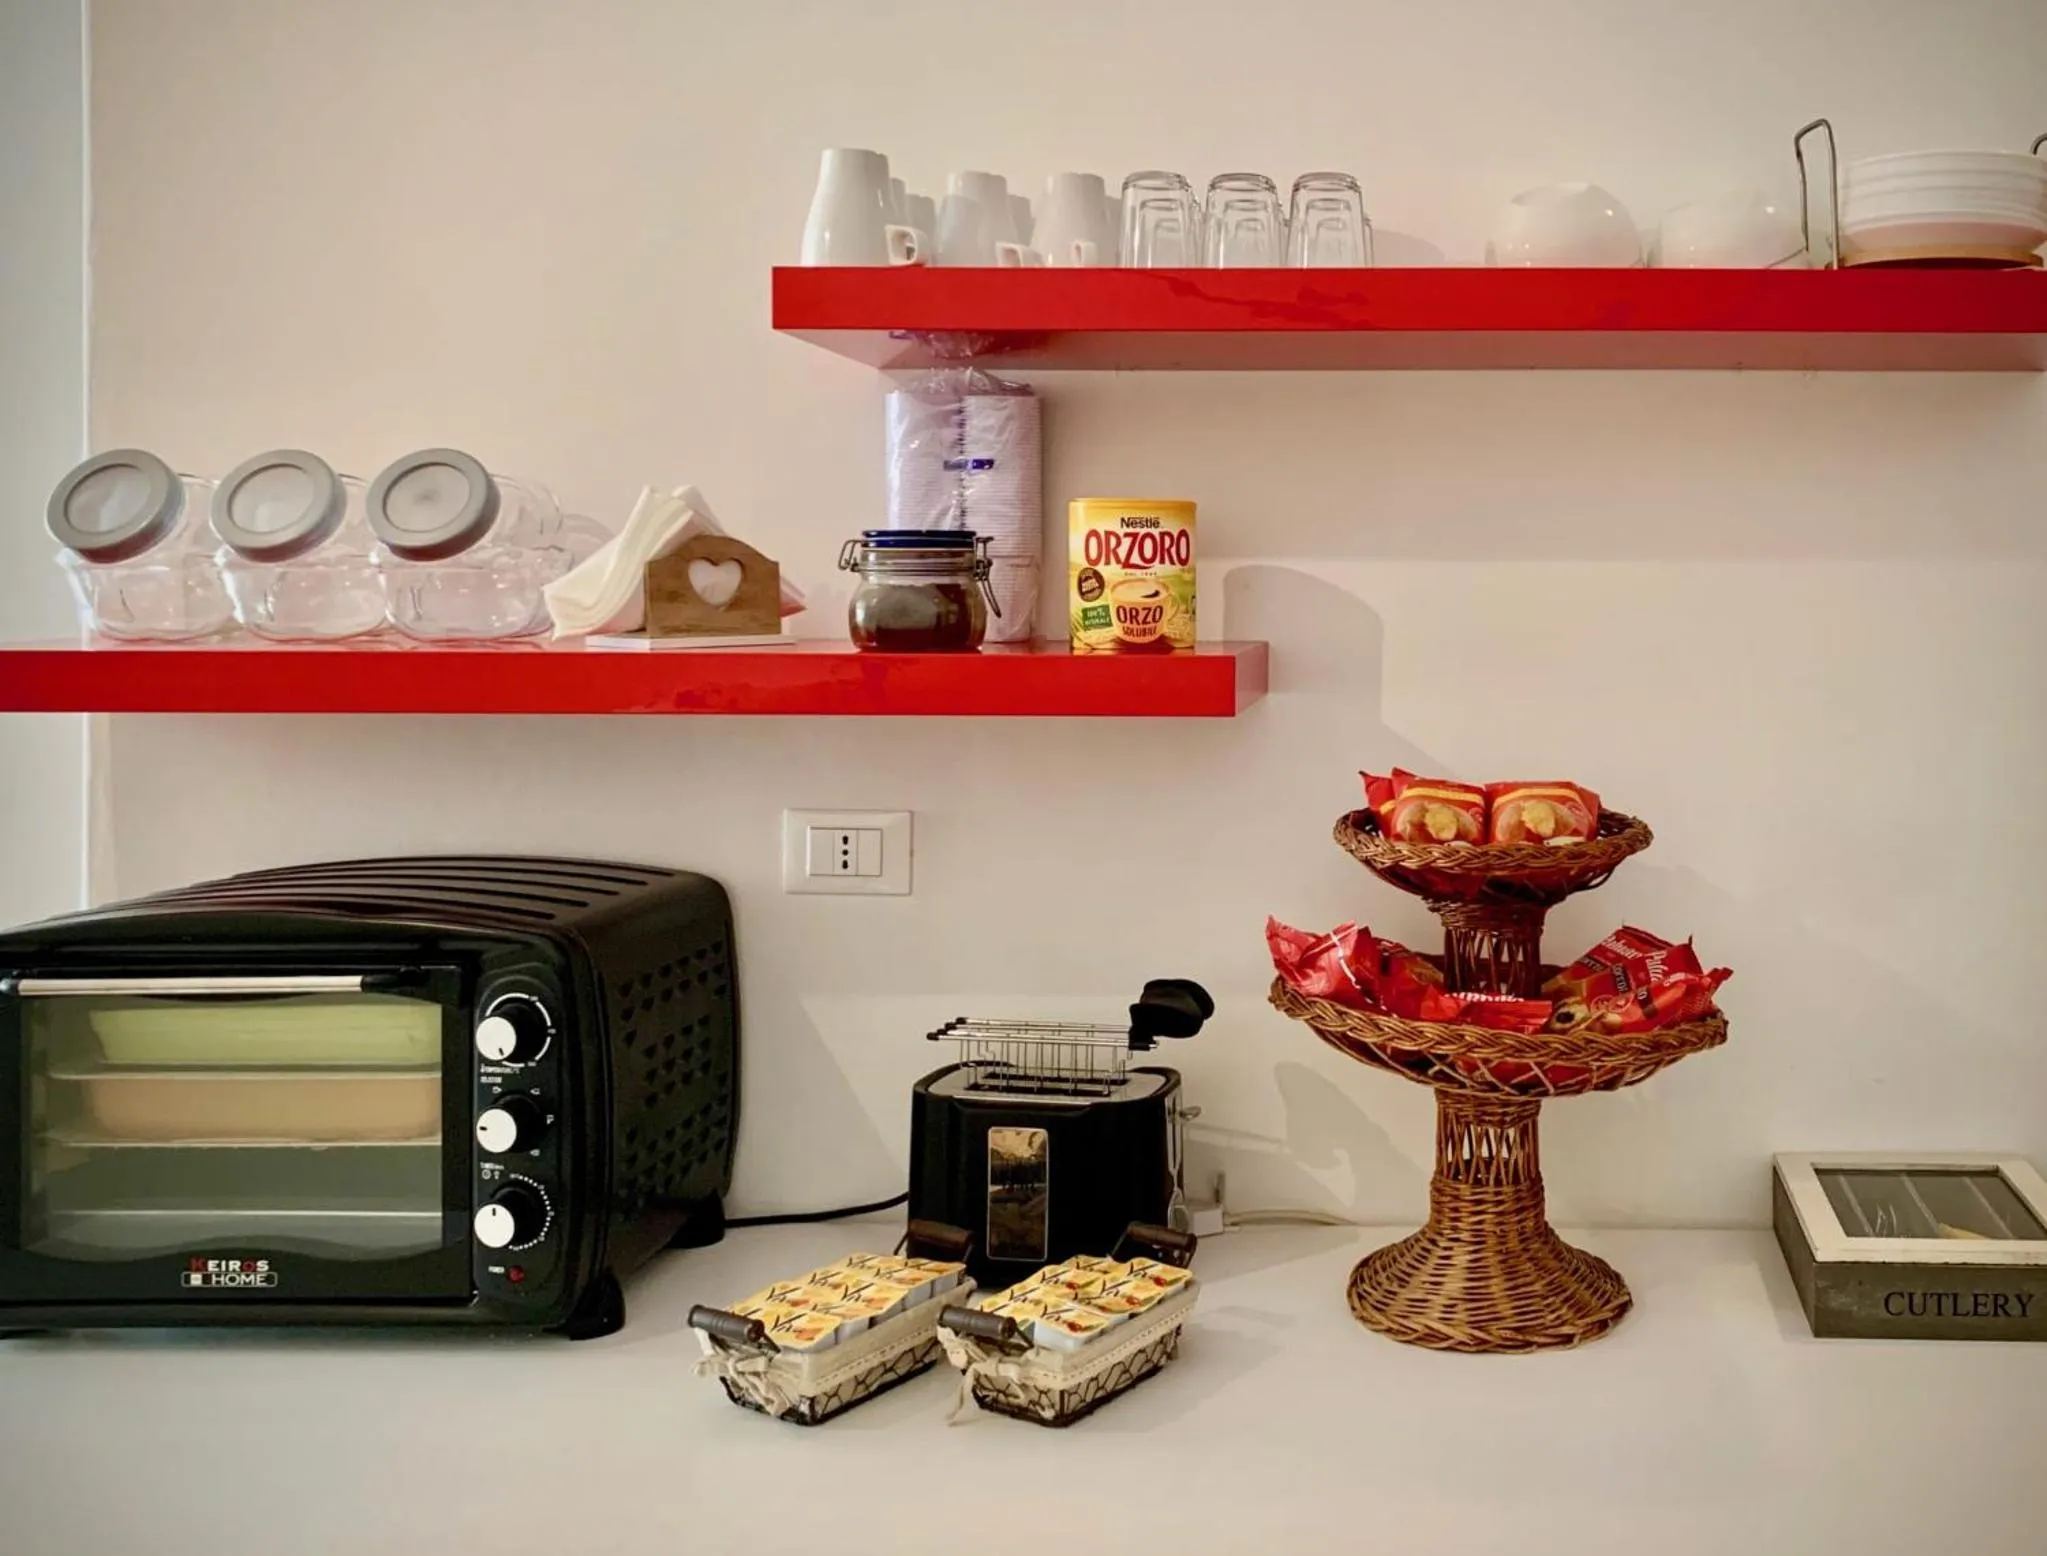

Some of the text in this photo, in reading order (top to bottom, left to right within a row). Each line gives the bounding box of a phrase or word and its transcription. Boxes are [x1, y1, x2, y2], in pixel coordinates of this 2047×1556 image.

[1084, 528, 1191, 570] ORZORO
[1116, 605, 1164, 626] ORZO
[190, 1257, 270, 1272] KEIROS
[212, 1273, 268, 1287] HOME
[1883, 1291, 2035, 1318] CUTLERY
